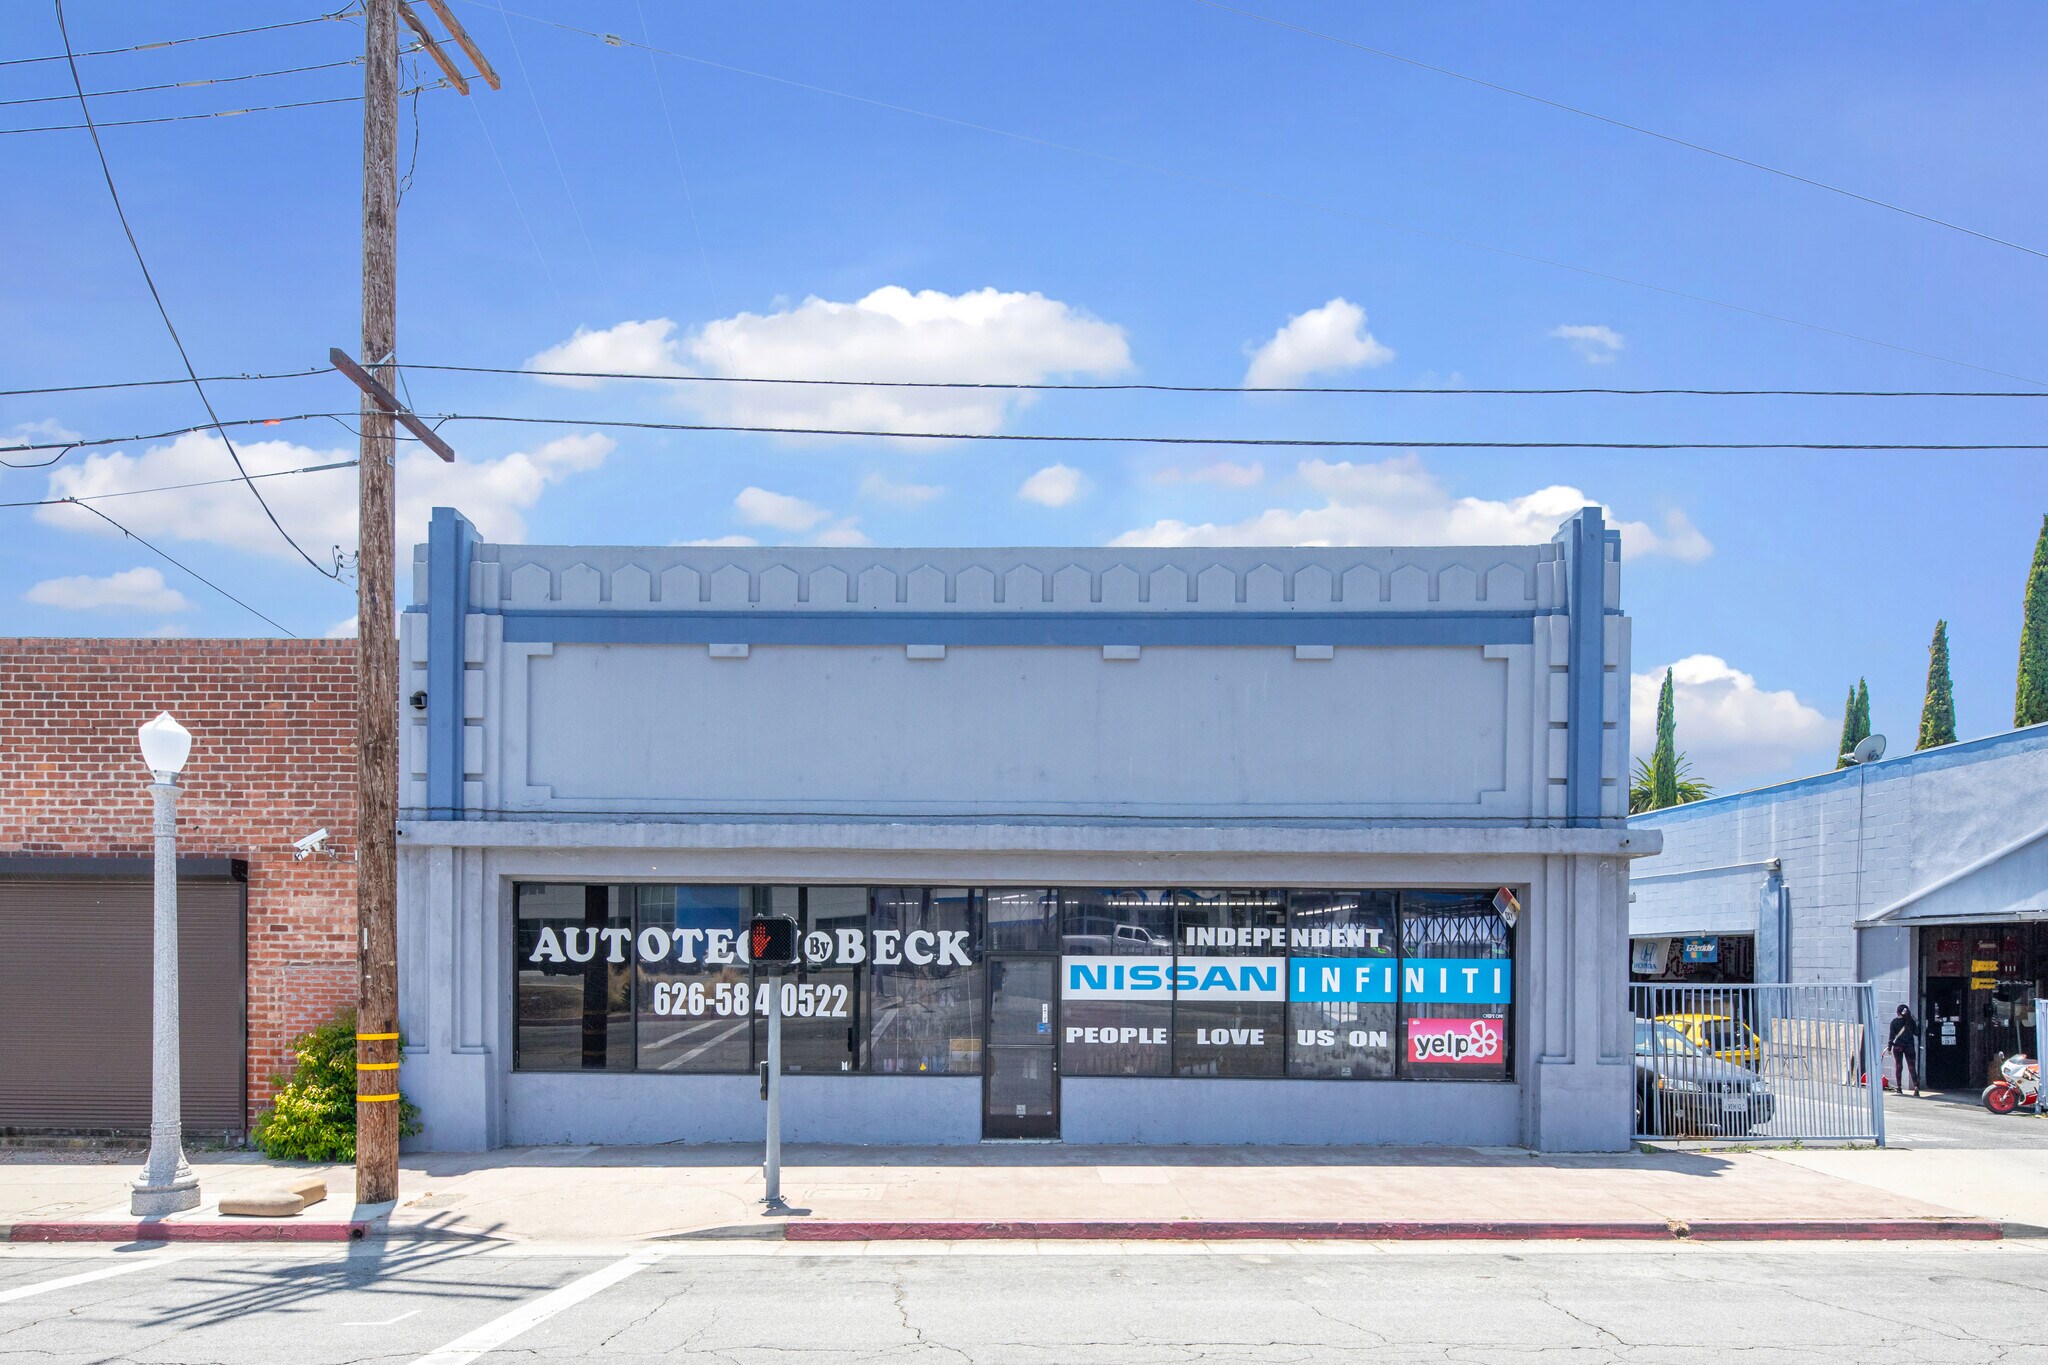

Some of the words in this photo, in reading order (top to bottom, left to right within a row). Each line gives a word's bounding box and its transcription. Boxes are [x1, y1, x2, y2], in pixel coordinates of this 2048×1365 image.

[529, 926, 801, 965] AUTOTE
[809, 937, 829, 959] By
[835, 928, 972, 966] BECK
[1186, 927, 1384, 948] INDEPENDENT
[1069, 964, 1277, 992] NISSAN
[1634, 962, 1657, 970] HONDA
[1298, 966, 1501, 994] INFINITI
[654, 982, 848, 1018] 626-5840522
[1066, 1027, 1168, 1044] PEOPLE
[1197, 1028, 1265, 1046] LOVE
[1297, 1029, 1335, 1046] US
[1349, 1030, 1387, 1047] ON
[1416, 1032, 1469, 1058] yelp
